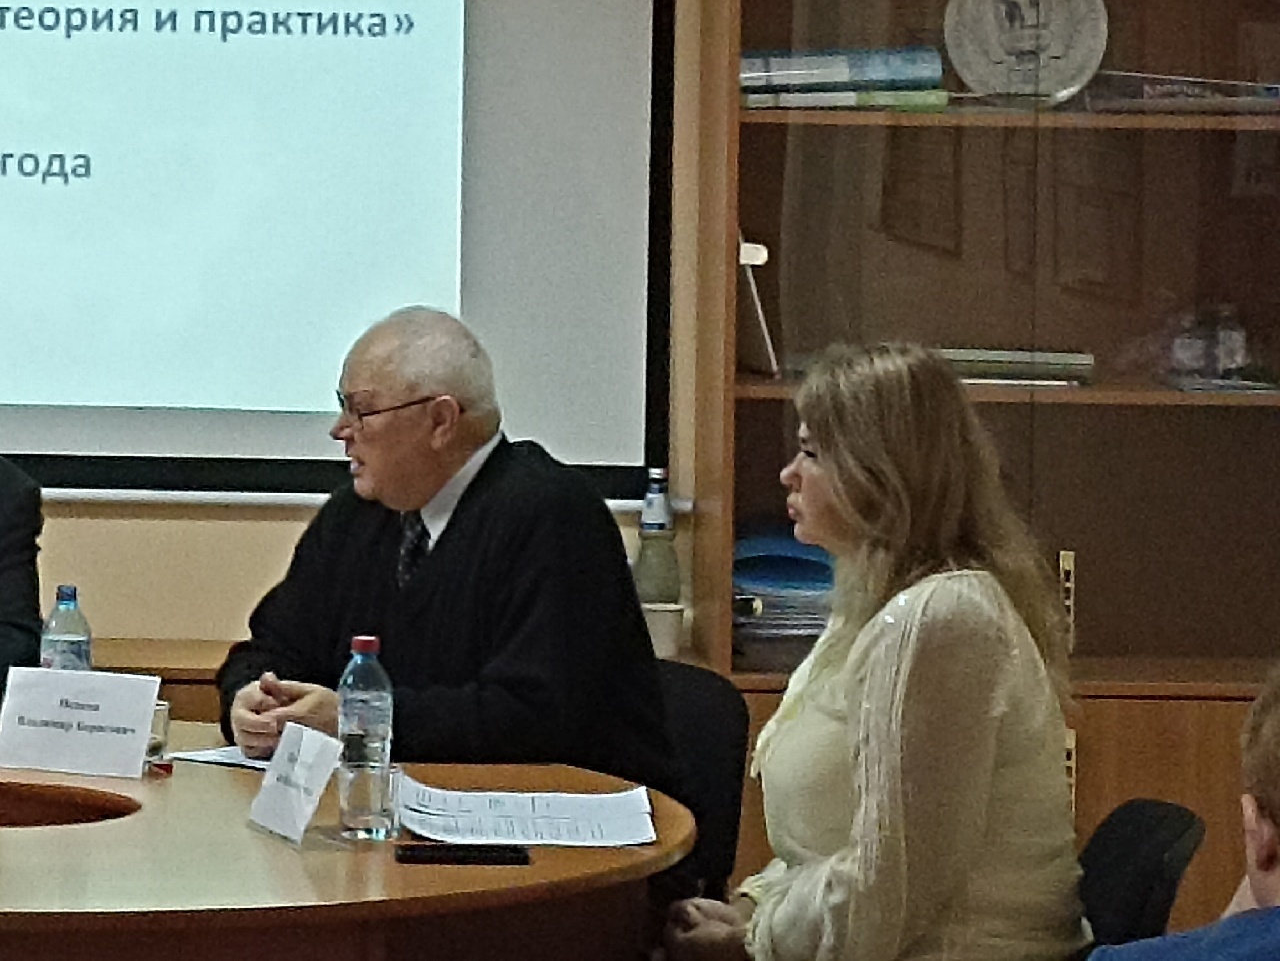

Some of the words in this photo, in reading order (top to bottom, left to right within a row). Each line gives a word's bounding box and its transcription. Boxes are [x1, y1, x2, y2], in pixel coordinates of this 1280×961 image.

[154, 9, 178, 33] и
[193, 9, 415, 42] практика»
[0, 151, 92, 186] года
